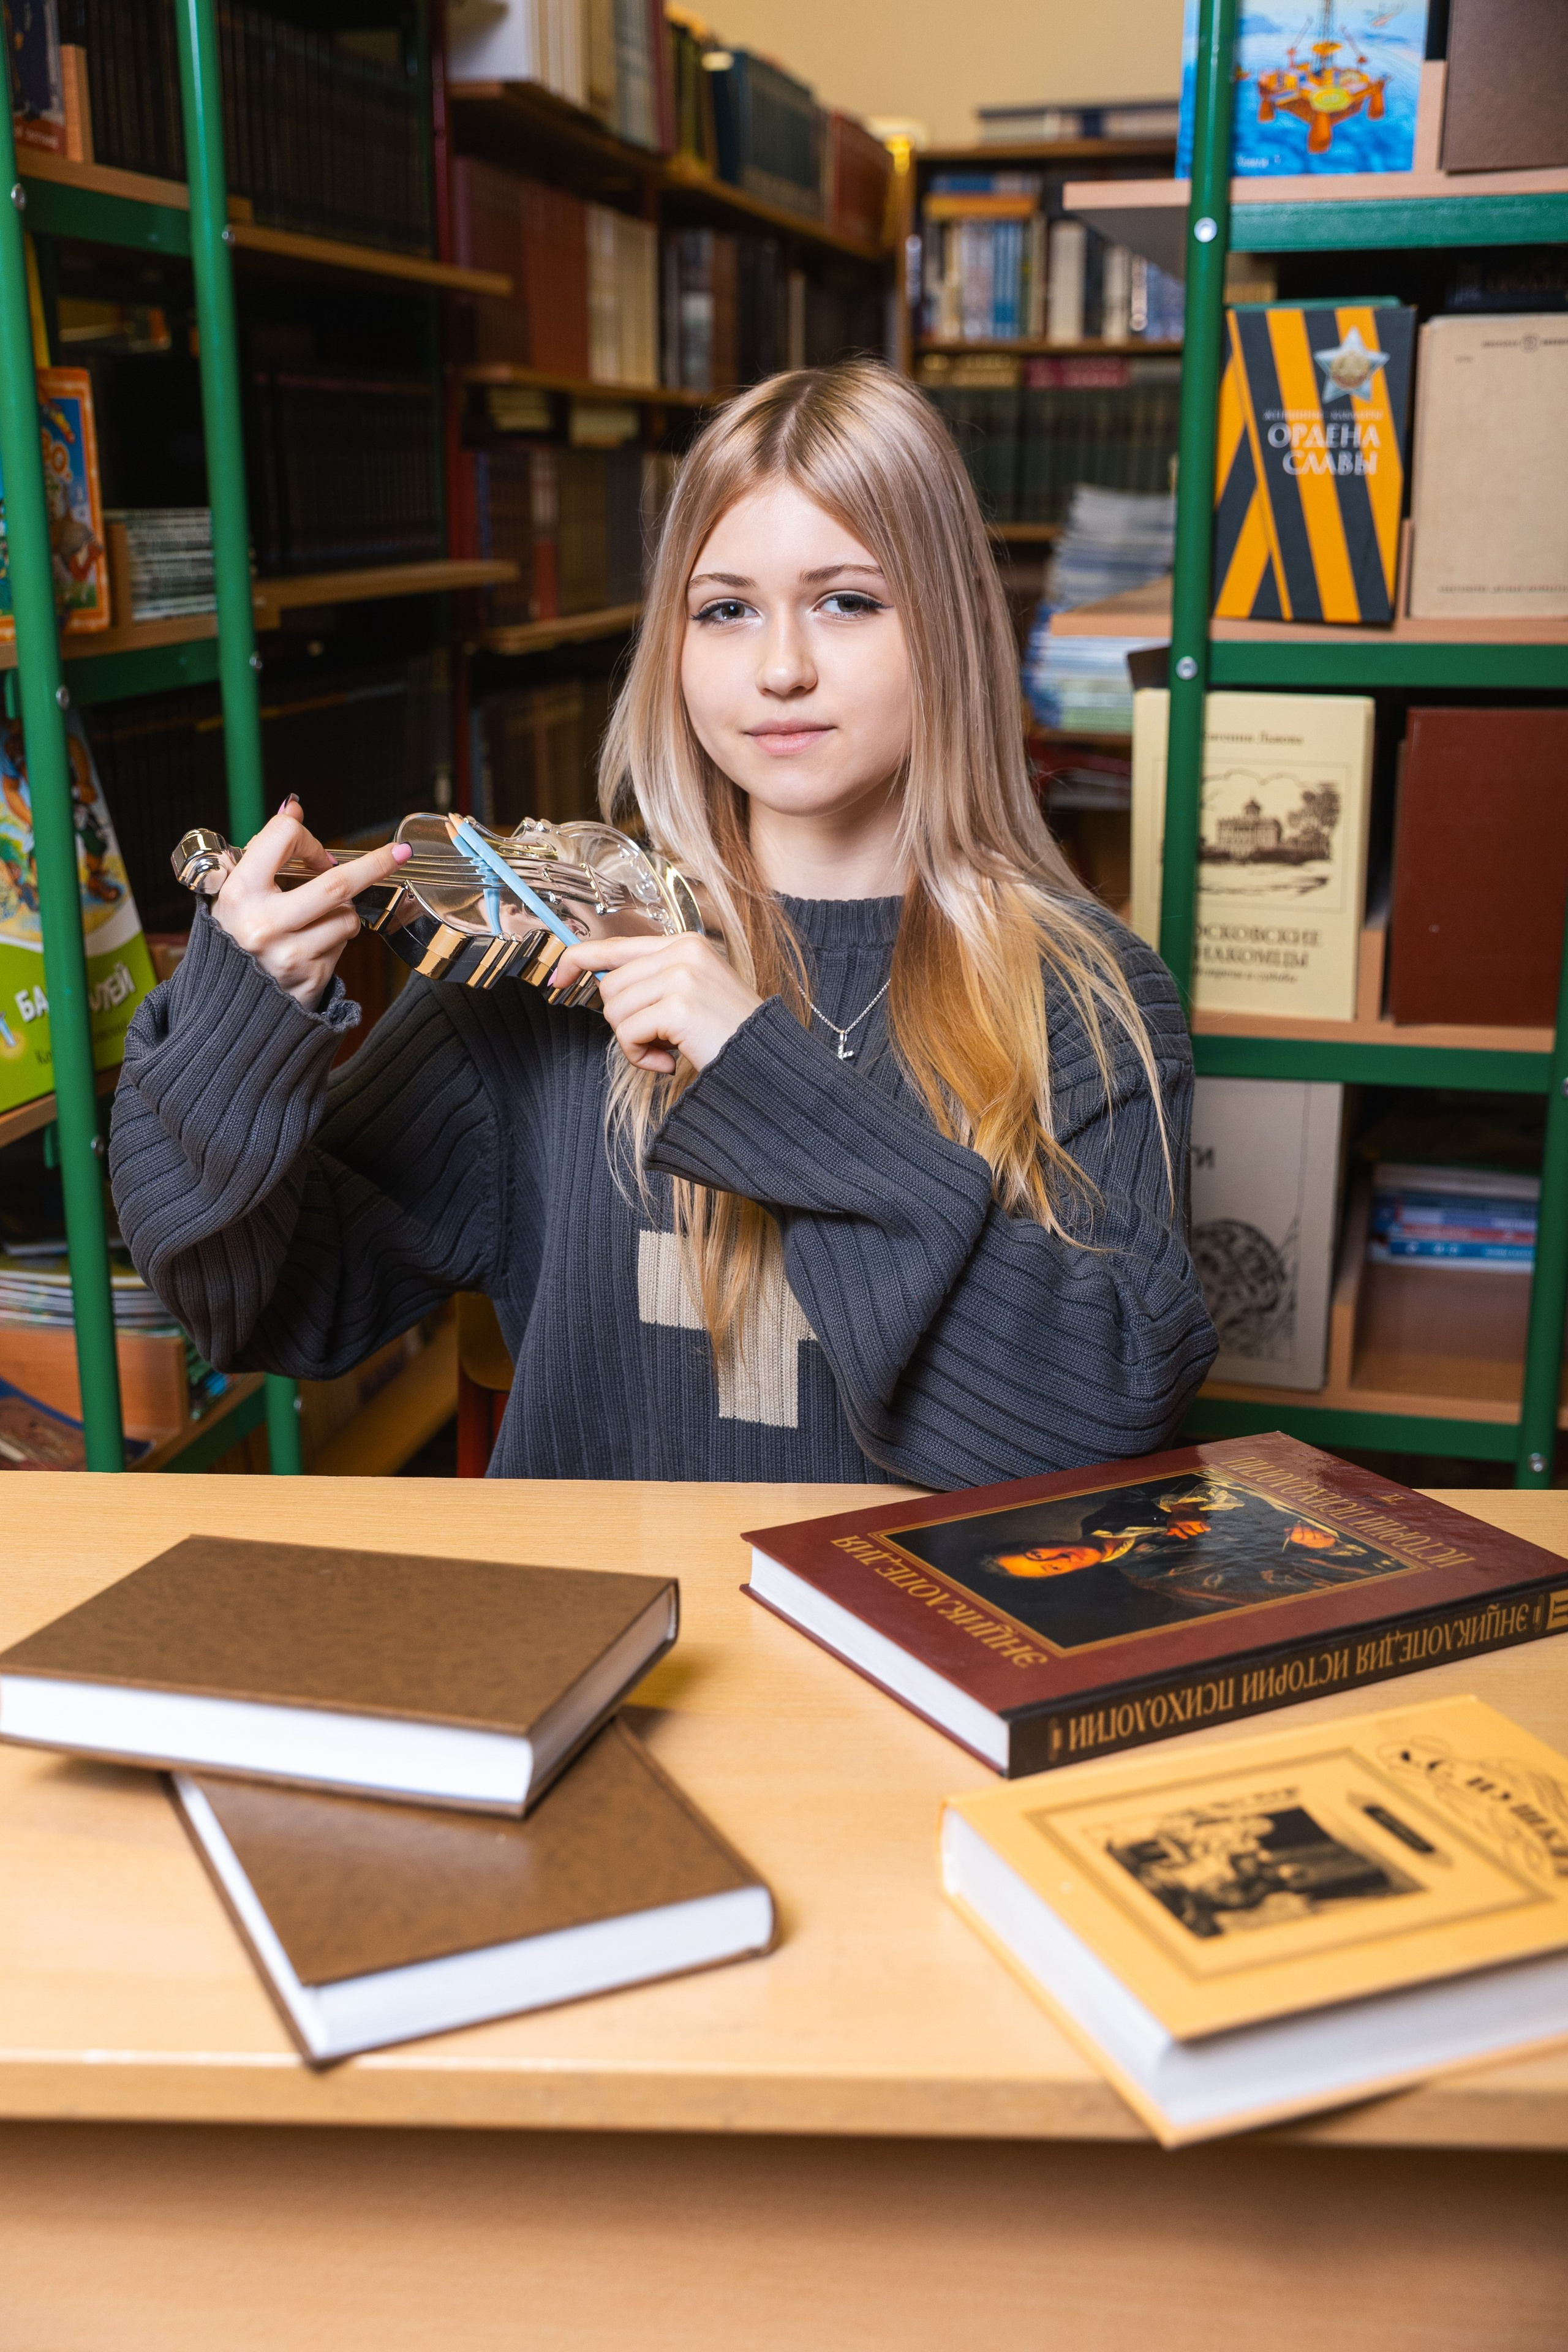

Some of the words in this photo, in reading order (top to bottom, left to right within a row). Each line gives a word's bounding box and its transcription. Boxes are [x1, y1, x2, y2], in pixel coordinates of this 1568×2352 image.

[1267, 422, 1381, 449] ОРДЕНА
[1282, 450, 1378, 476] СЛАВЫ
[1194, 921, 1322, 947] ОСКОВСКИЕ
[1194, 944, 1309, 968] НАКОМЦЫ
[1219, 1455, 1375, 1522] ПСИХОЛОГИИ
[1348, 1515, 1476, 1569] ИСТОРИИ
[830, 1535, 1048, 1668] ЭНЦИКЛОПЕДИЯ
[1355, 1603, 1529, 1675] ЭНЦИКЛОПЕДИЯ
[1241, 1648, 1349, 1705] ИСТОРИИ
[1069, 1677, 1235, 1752] ПСИХОЛОГИИ
